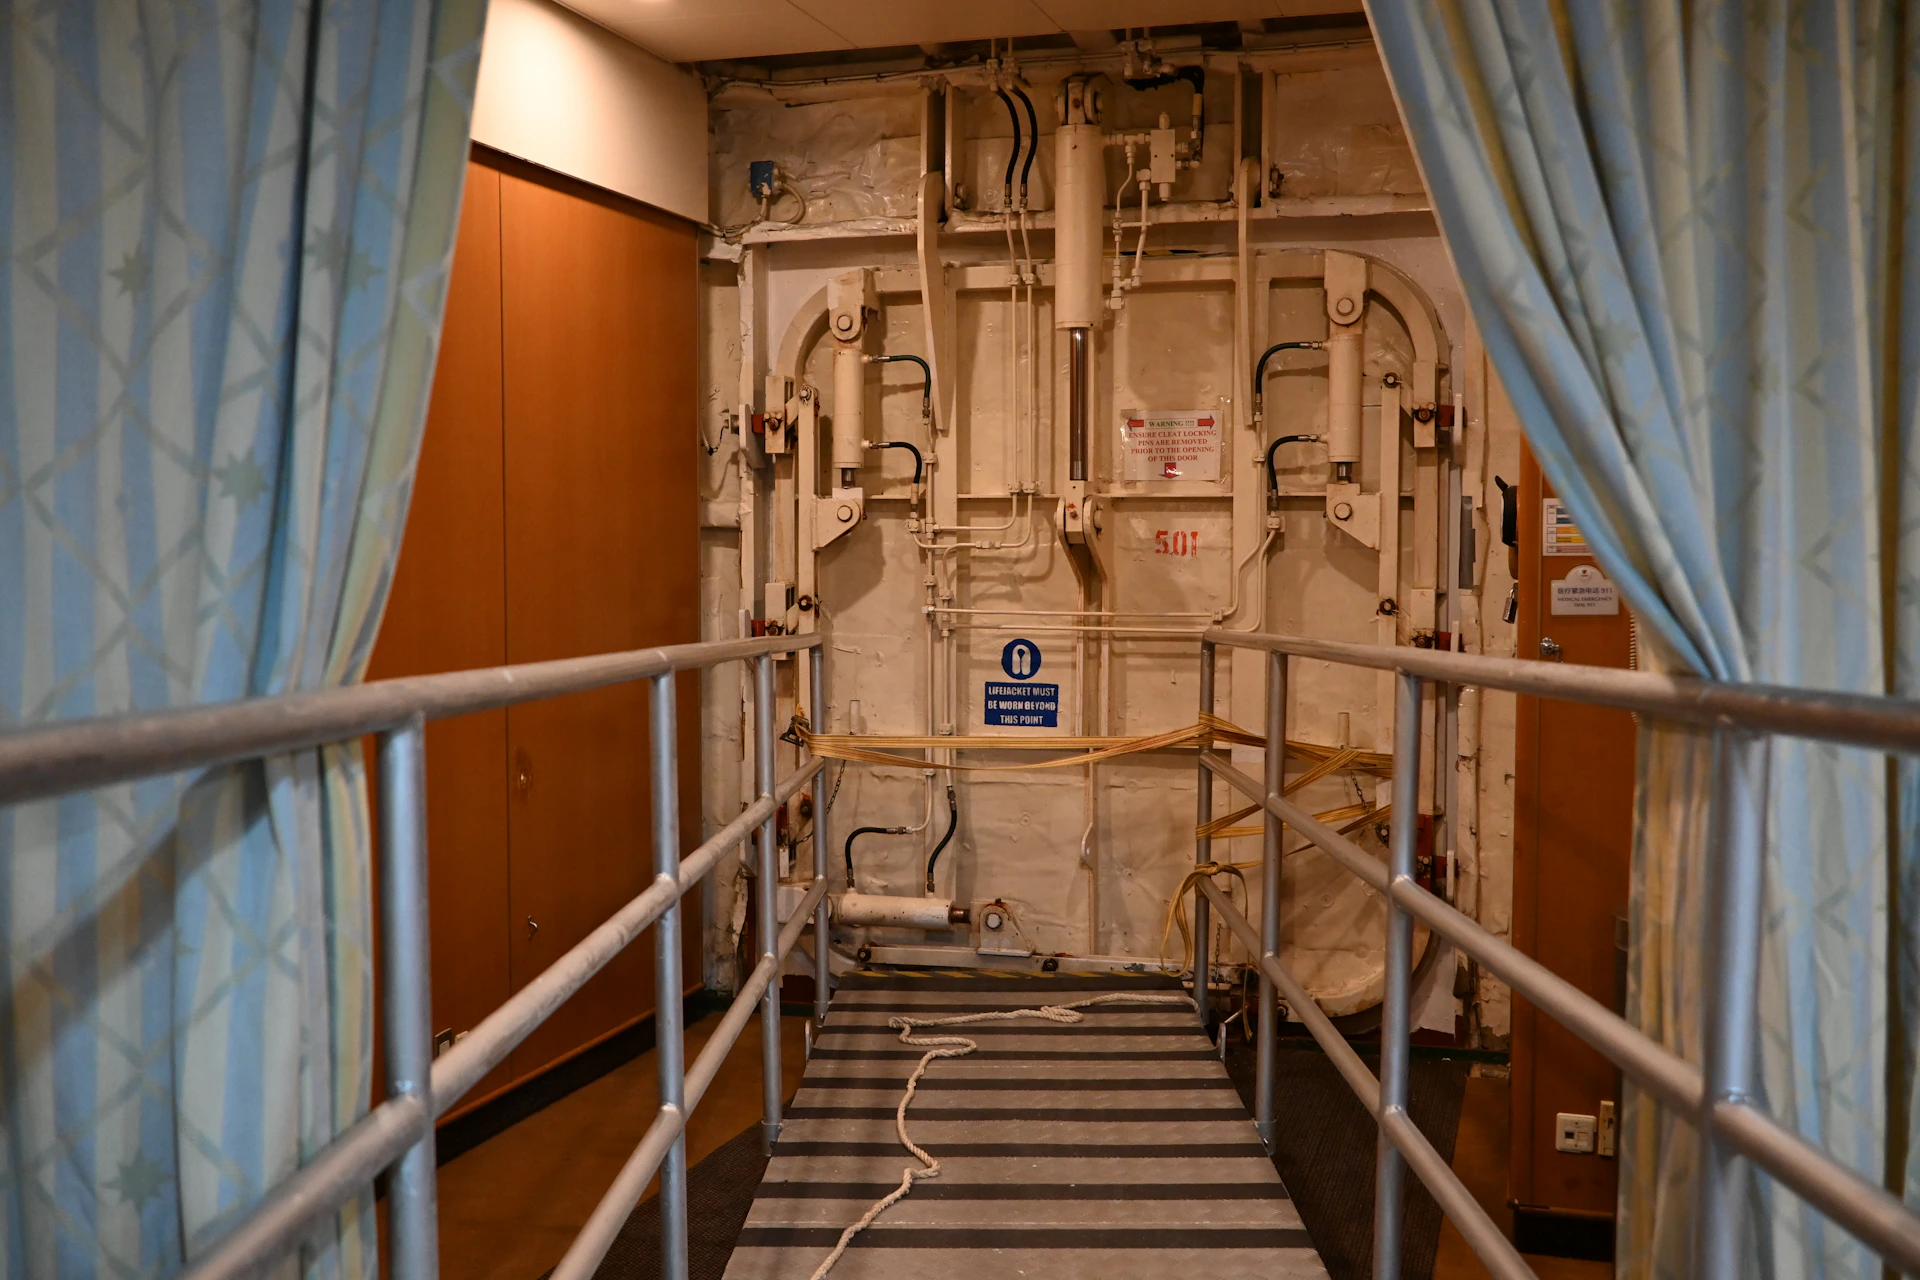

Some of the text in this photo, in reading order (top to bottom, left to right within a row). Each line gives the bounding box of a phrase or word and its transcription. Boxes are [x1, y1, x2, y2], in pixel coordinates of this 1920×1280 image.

[1557, 587, 1600, 595] 医疗紧急电话
[988, 686, 1056, 697] LIFEJACKET MUST
[988, 700, 1056, 711] BE WORN BEYOND
[1000, 715, 1044, 725] THIS POINT
